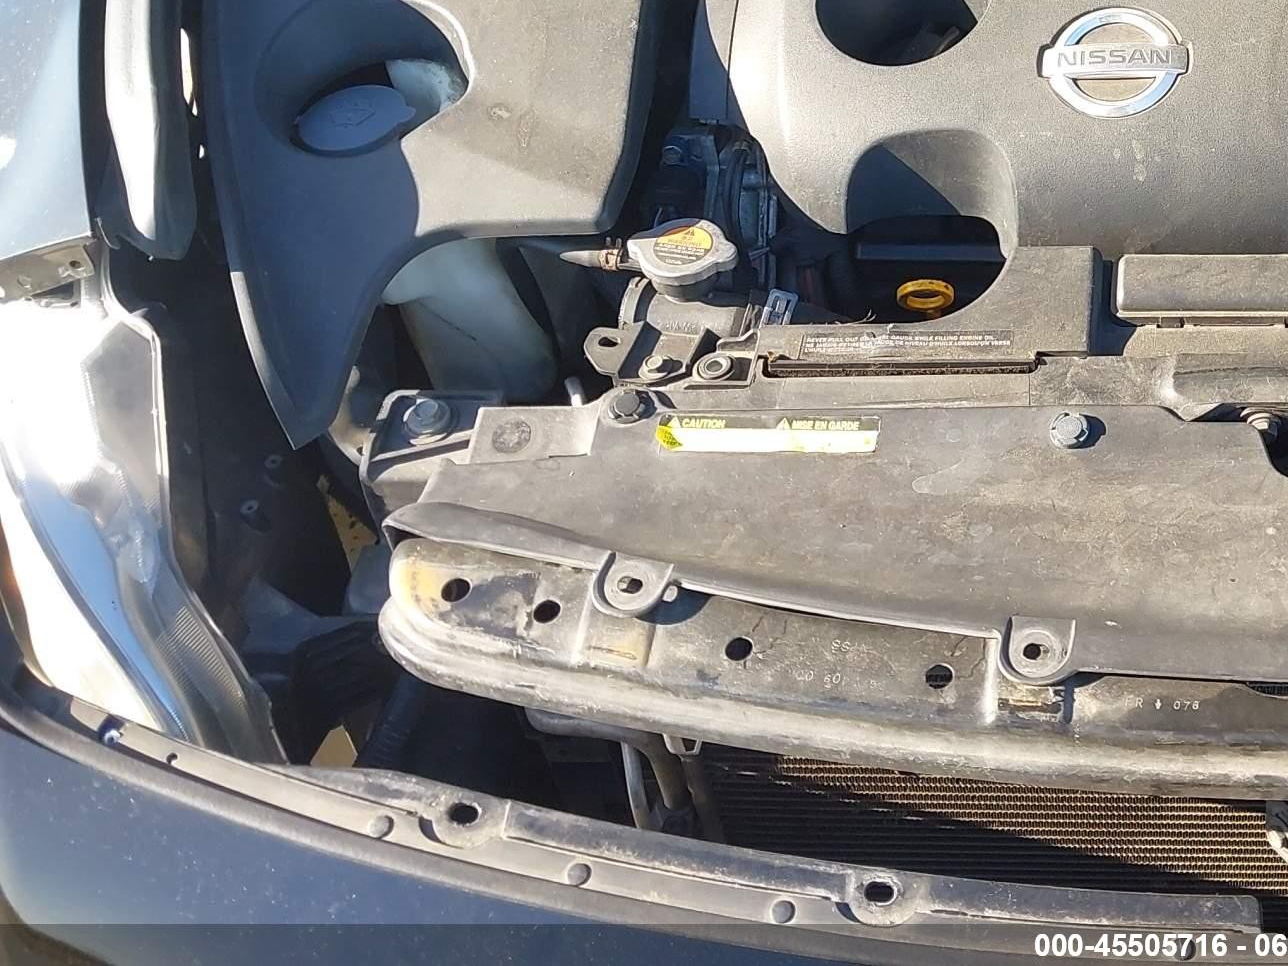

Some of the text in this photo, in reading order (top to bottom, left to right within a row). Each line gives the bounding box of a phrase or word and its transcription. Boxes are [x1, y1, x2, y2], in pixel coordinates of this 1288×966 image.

[1057, 48, 1172, 68] NISSAN
[682, 419, 860, 430] CAUTION MISE EN GARDE
